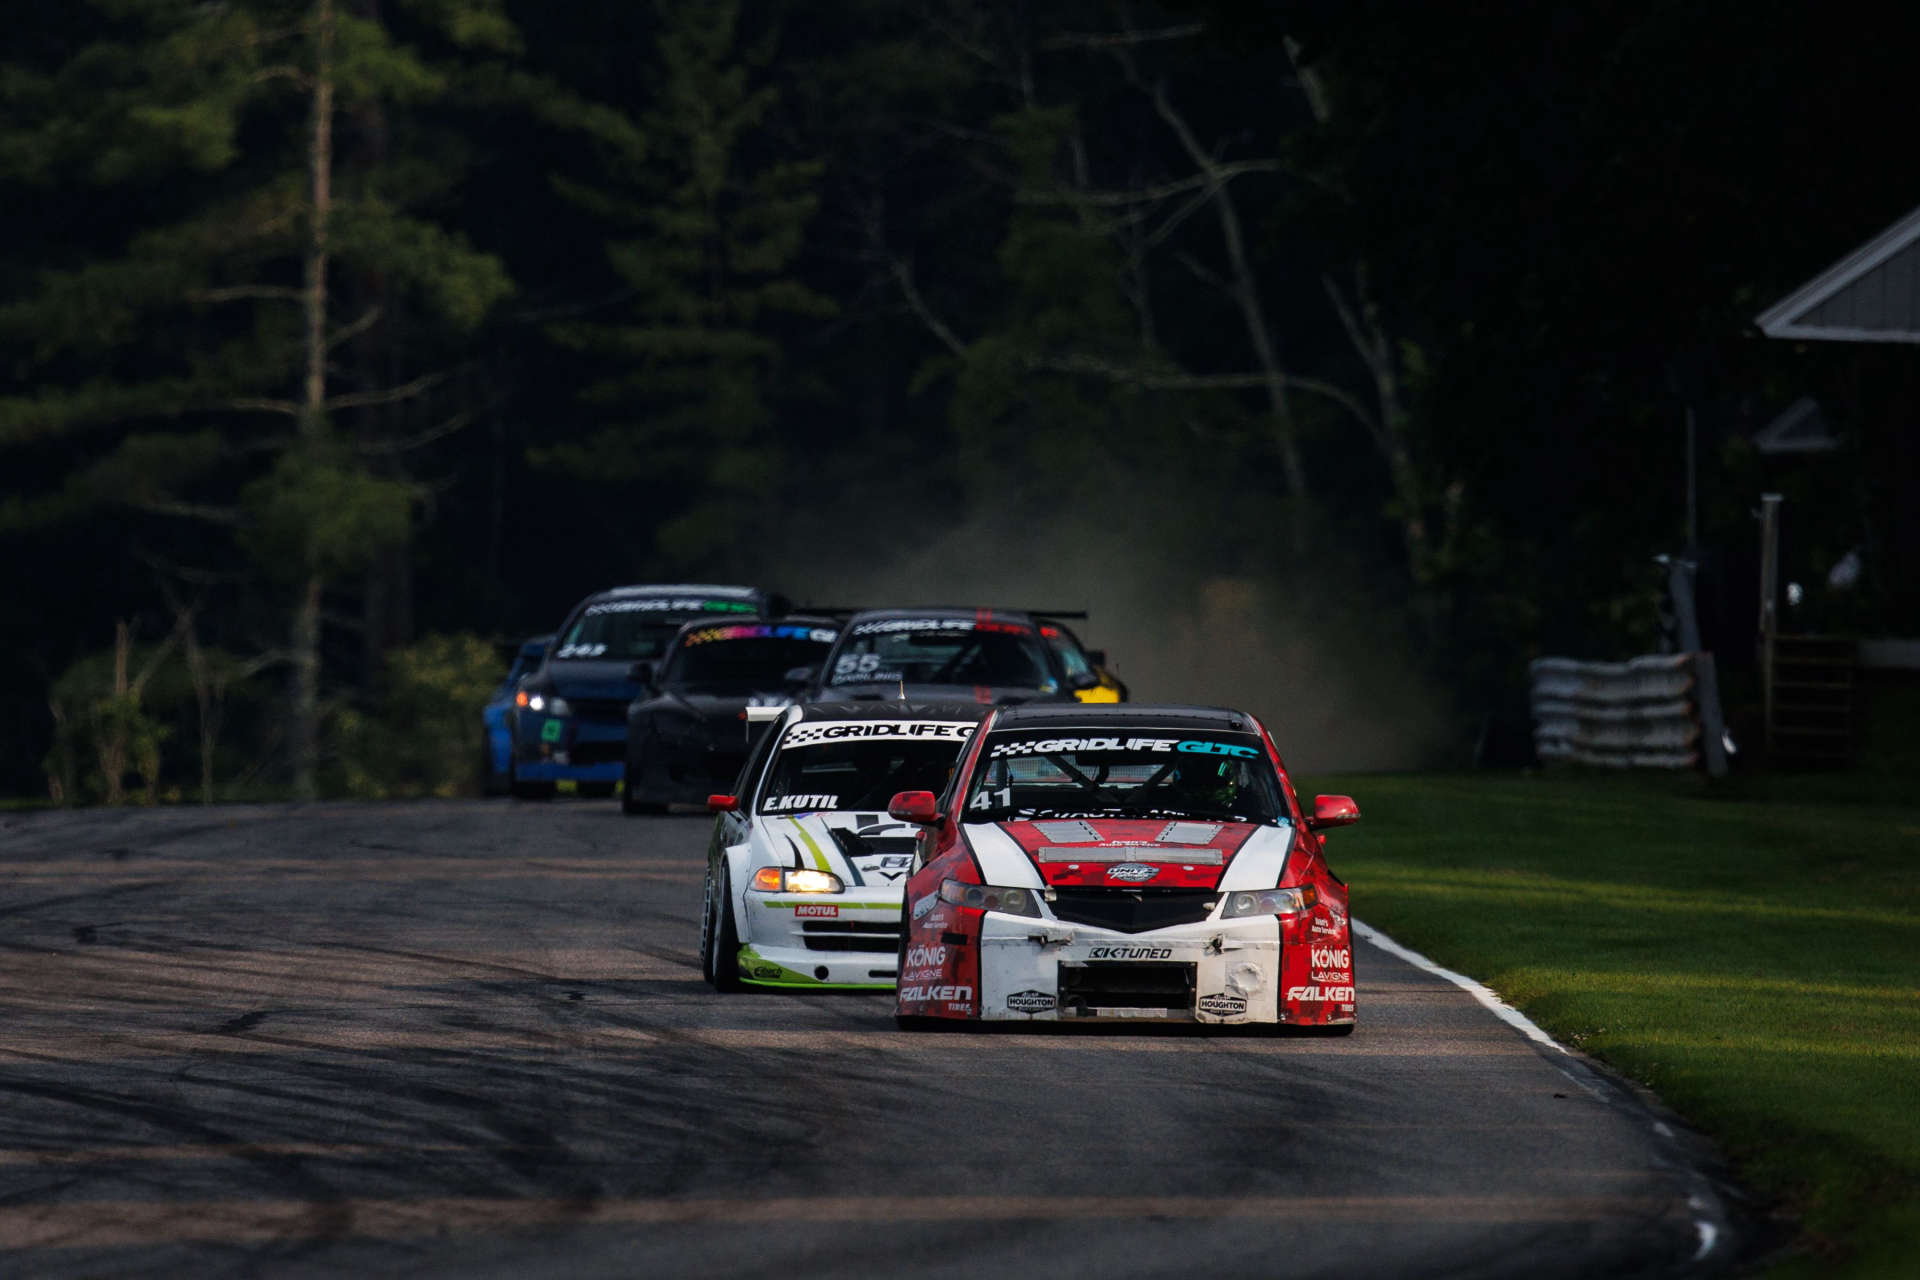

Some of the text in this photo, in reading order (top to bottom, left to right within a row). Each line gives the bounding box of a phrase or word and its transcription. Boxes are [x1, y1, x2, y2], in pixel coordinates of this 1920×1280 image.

[823, 724, 956, 738] GRIDLIFE
[1034, 738, 1179, 752] GRIDLIFE
[763, 794, 838, 812] E.KUTIL
[970, 788, 1011, 810] 41
[797, 905, 838, 916] MOTUL
[907, 945, 945, 967] KÖNIG
[1312, 946, 1349, 968] KÖNIG
[1312, 972, 1349, 982] LAVIGNE
[900, 986, 972, 1001] FALKEN
[1287, 986, 1355, 1002] FALKEN
[1009, 997, 1053, 1007] HOUGHTON
[1201, 1000, 1245, 1010] HOUGHTON
